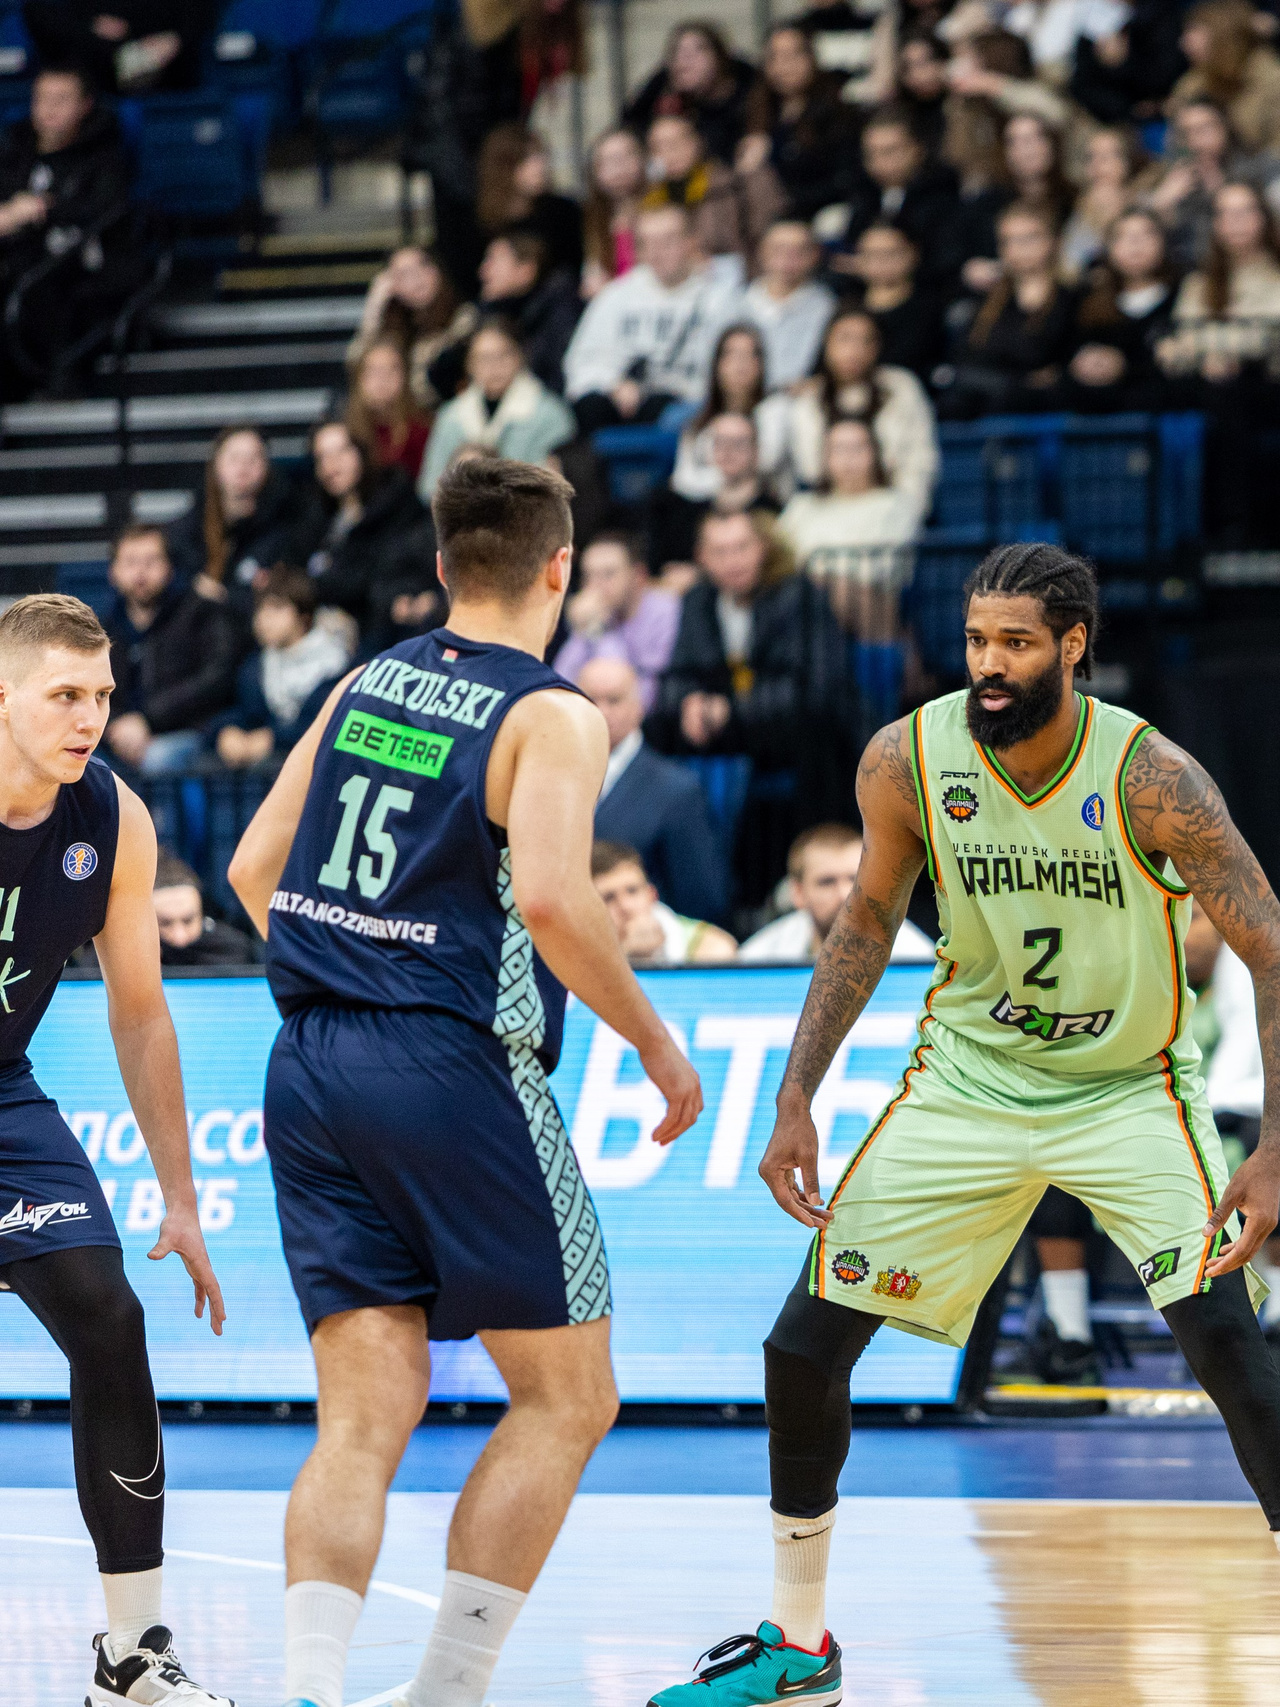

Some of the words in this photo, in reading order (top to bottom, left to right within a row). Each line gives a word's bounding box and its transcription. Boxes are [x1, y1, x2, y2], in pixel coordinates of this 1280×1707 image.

[350, 658, 506, 730] MIKULSKI
[345, 721, 442, 767] BETERA
[317, 774, 414, 900] 15
[952, 843, 1049, 858] VERDLOVSK
[1023, 927, 1063, 991] 2
[125, 1178, 238, 1231] ВБ
